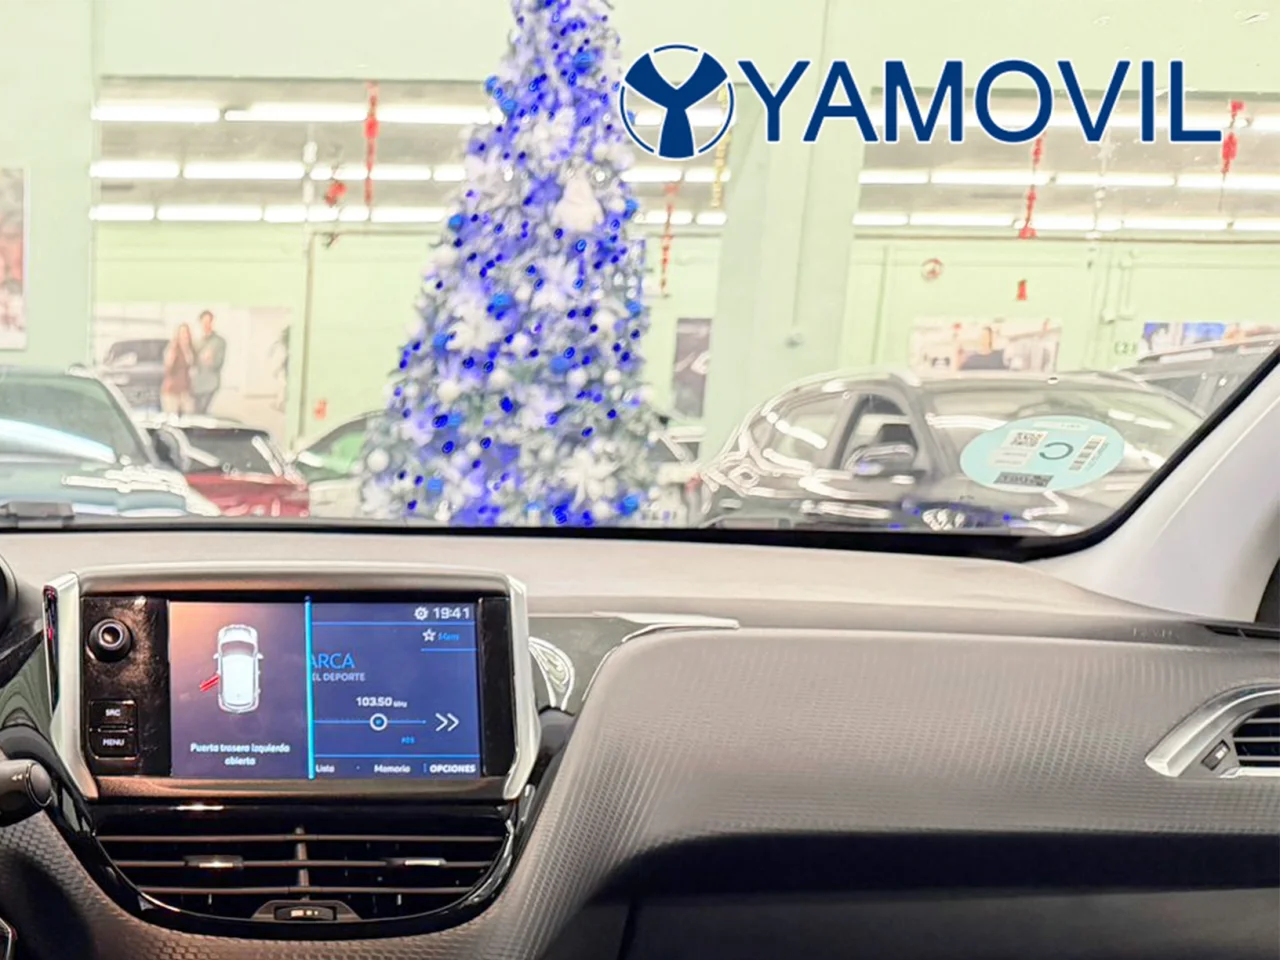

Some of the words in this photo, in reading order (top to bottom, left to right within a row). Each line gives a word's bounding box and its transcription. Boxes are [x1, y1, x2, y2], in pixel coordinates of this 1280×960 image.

[432, 607, 470, 620] 19:41
[323, 672, 366, 682] DEPORTE
[190, 742, 219, 753] Puerta
[220, 742, 250, 753] trasera
[374, 764, 411, 774] Memoria
[429, 764, 477, 774] OPCIONES
